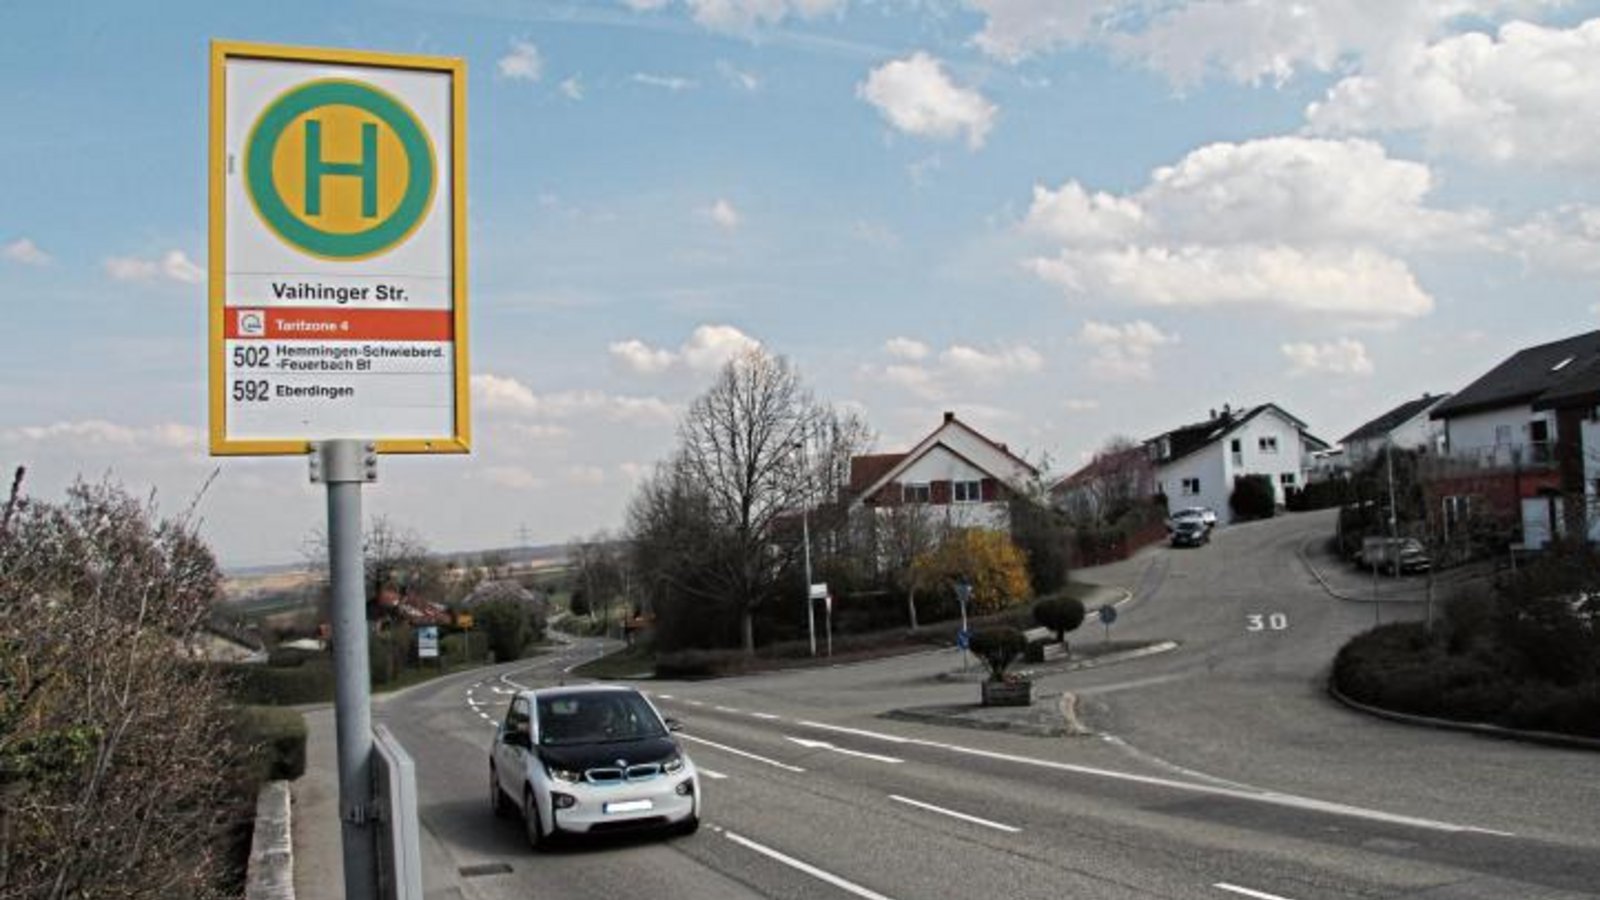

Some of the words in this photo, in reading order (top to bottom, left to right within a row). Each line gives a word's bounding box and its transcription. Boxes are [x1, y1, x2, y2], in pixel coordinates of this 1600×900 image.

[305, 119, 377, 218] H
[272, 283, 369, 304] Vaihinger
[376, 284, 409, 301] Str.
[275, 319, 337, 332] Tarifzone
[340, 320, 350, 332] 4
[233, 346, 270, 368] 502
[276, 344, 445, 358] Hemmingen-Schwieberd.
[276, 358, 353, 371] -Feuerbach
[356, 358, 371, 371] Bf
[233, 380, 270, 401] 592
[276, 385, 354, 398] Eberdingen
[1246, 612, 1288, 632] 30
